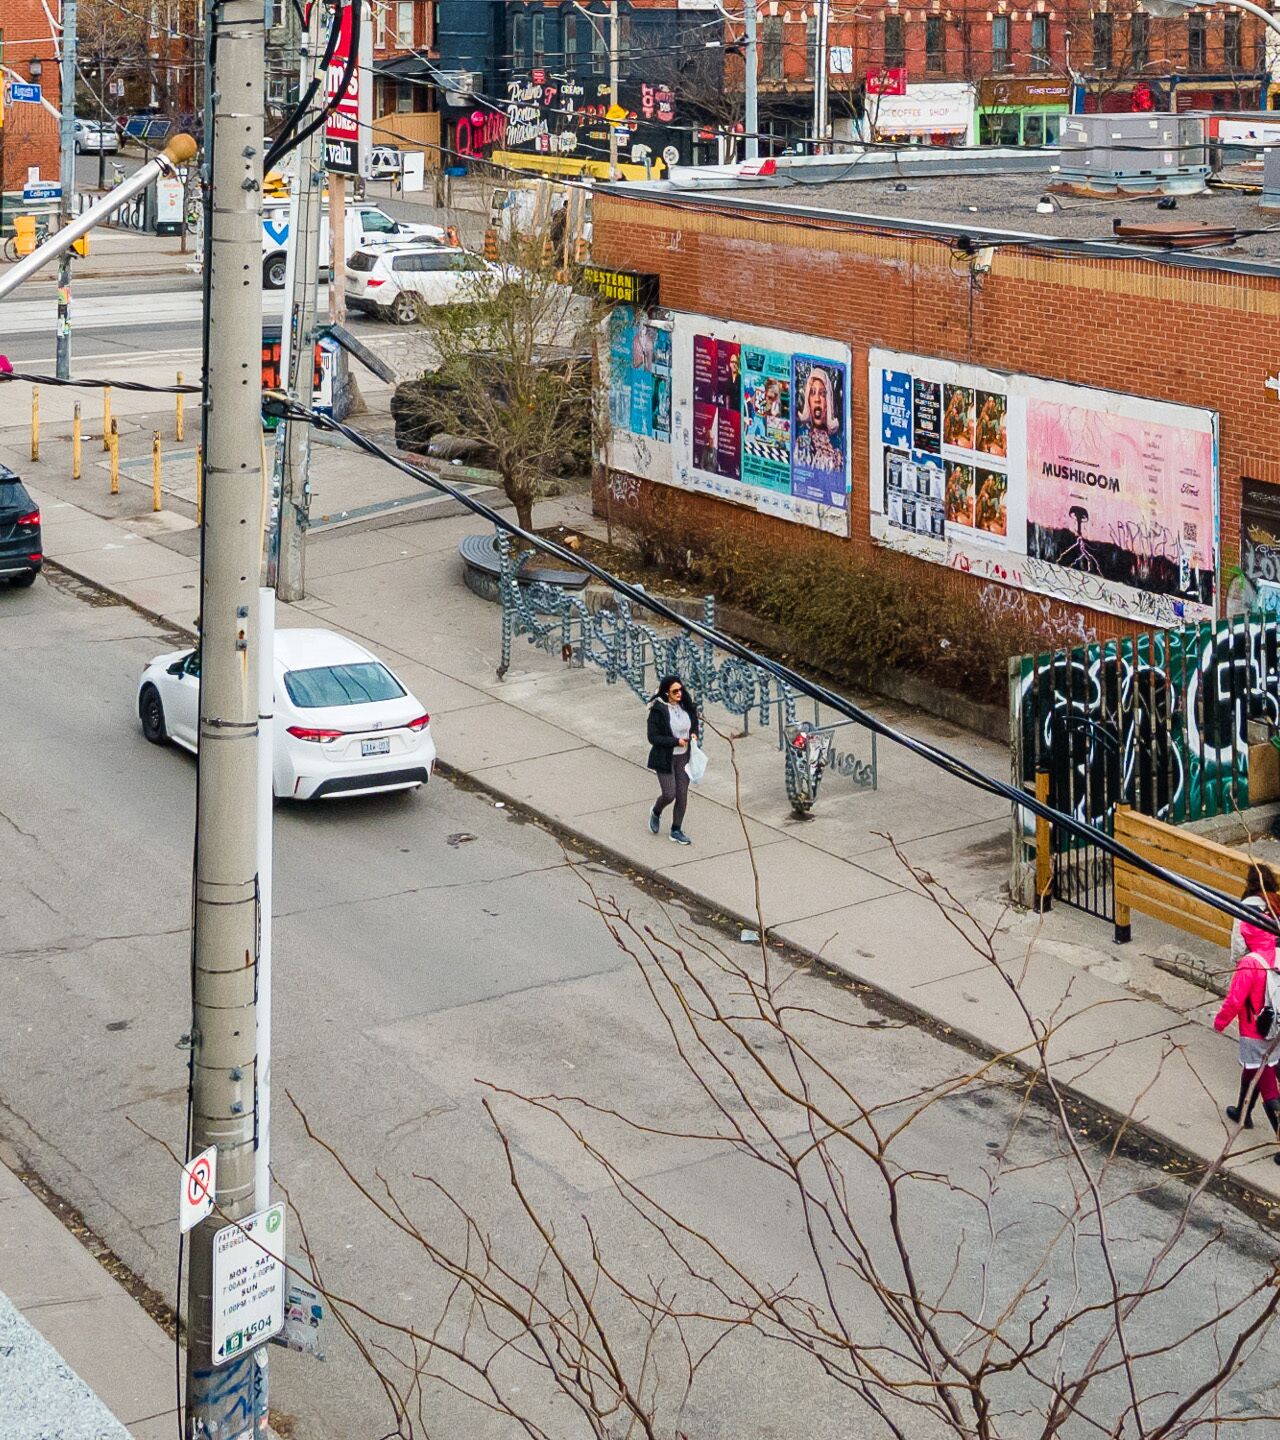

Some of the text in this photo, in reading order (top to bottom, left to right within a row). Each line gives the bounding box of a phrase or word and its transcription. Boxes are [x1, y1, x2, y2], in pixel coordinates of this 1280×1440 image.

[882, 403, 907, 419] BUCKET
[889, 415, 909, 429] CREW
[1042, 461, 1120, 493] MUSHROOM
[1180, 482, 1200, 497] Ford
[228, 1265, 248, 1281] MON
[255, 1254, 271, 1268] SAT
[241, 1282, 259, 1297] SUN
[243, 1314, 273, 1338] 4504
